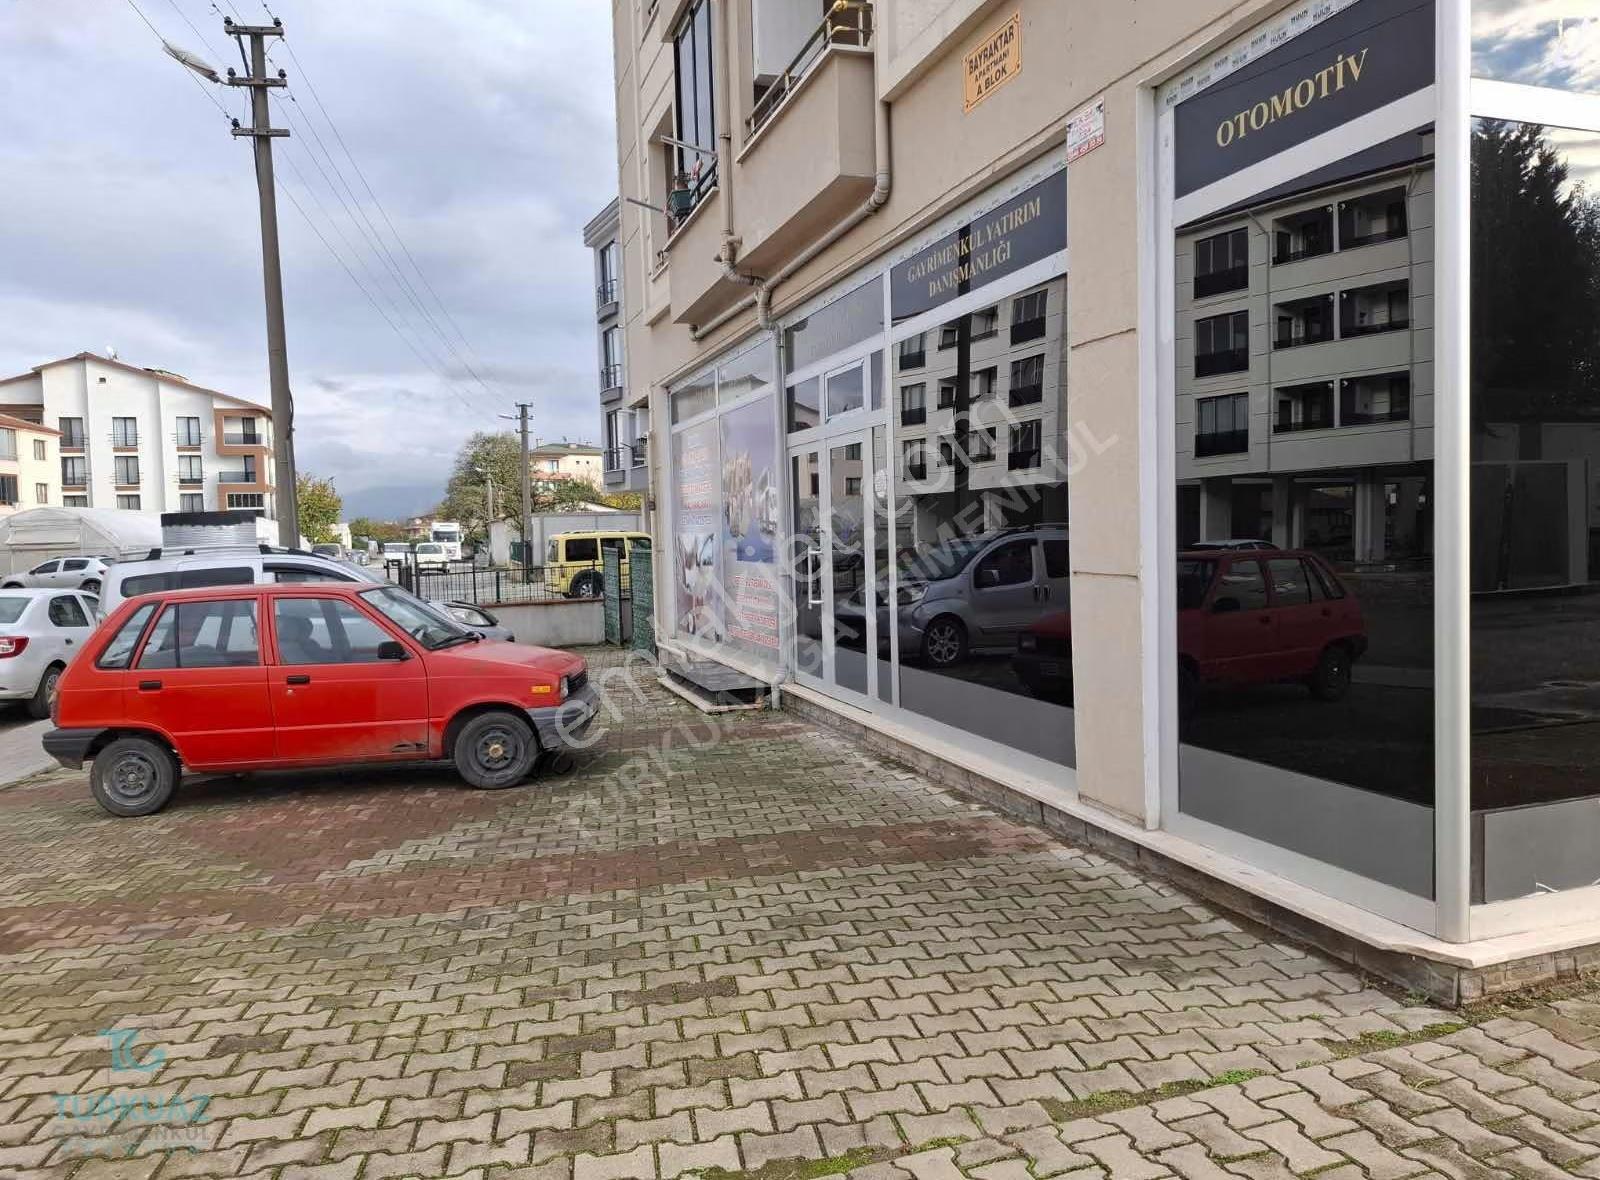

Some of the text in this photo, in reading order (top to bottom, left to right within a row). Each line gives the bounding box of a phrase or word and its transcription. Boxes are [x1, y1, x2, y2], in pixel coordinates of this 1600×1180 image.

[969, 24, 1015, 75] BAYRAKTAR
[976, 63, 1008, 97] A BLOK
[1216, 48, 1369, 147] OTOMOTİV
[907, 197, 1041, 283] GAYRİMENKUL YATIRIM
[929, 240, 1011, 298] DANIŞMANLIĞI
